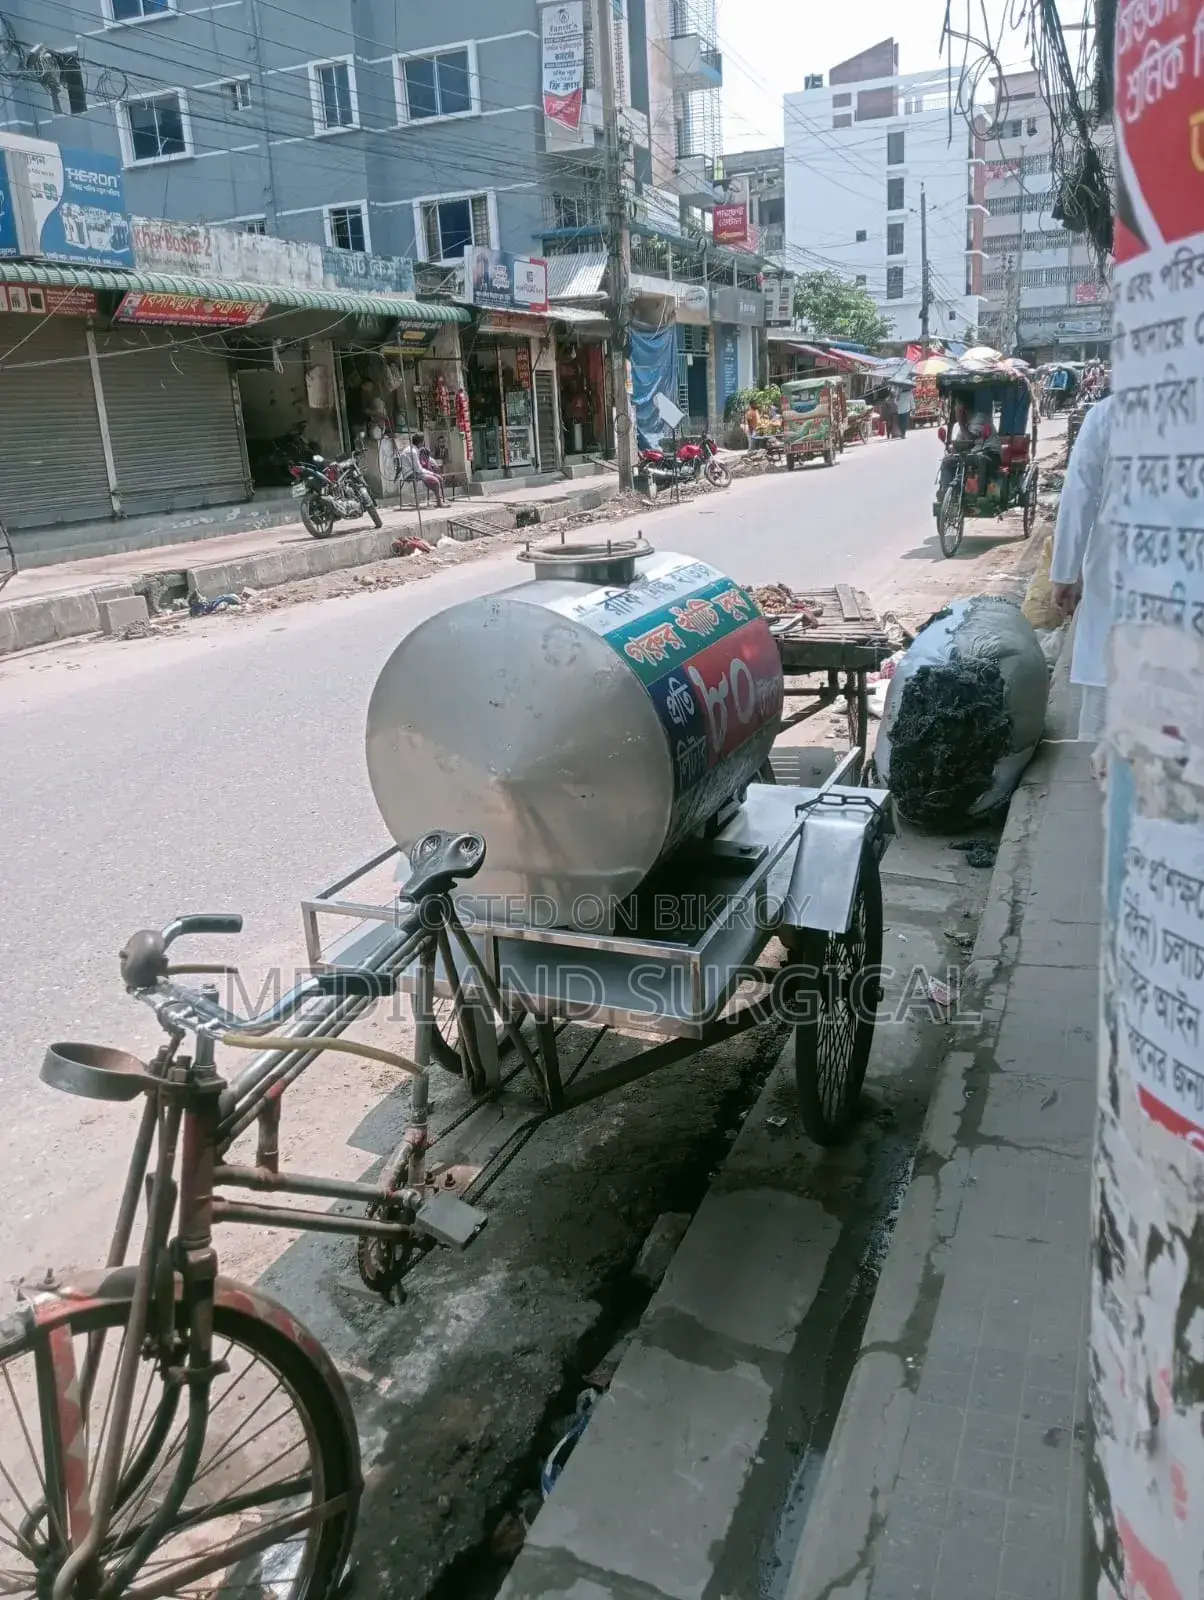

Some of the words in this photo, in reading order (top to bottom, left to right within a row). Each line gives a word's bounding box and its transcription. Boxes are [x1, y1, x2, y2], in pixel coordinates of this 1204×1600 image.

[65, 167, 118, 188] HERON
[623, 622, 686, 667] গরুর
[668, 598, 719, 637] খাঁটি
[710, 589, 751, 622] দুধ
[666, 676, 695, 726] প্রতি
